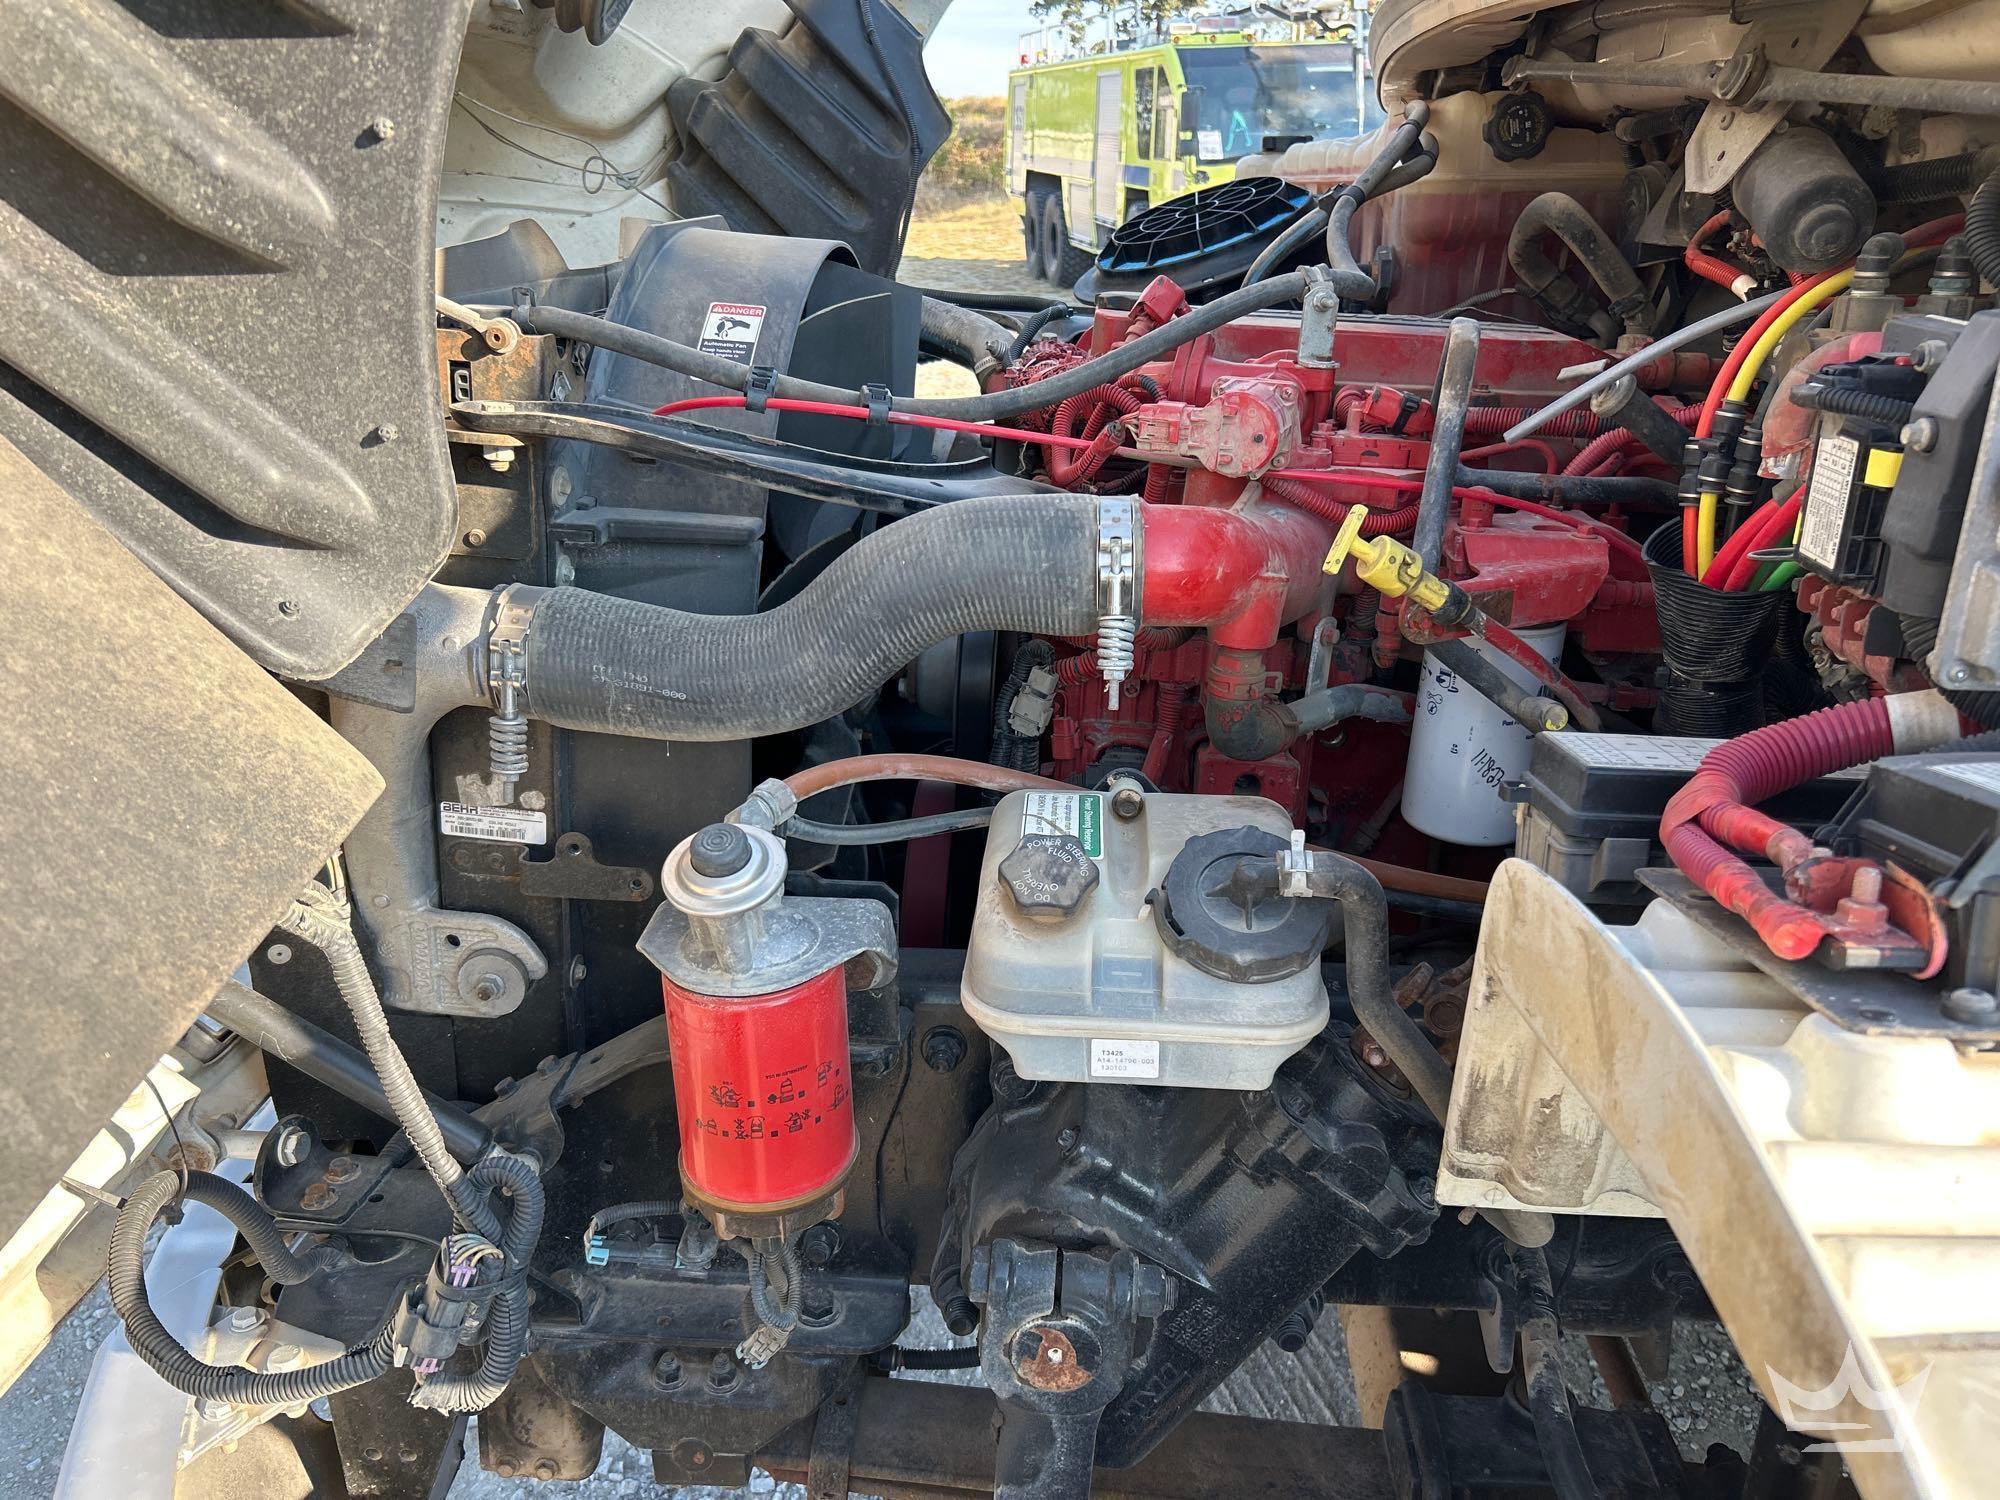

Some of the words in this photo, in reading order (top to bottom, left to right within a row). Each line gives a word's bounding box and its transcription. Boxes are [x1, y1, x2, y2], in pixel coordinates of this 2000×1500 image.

[723, 306, 763, 316] DANGER
[1838, 479, 1850, 520] WITHOUT
[443, 802, 479, 815] BEHR
[1084, 797, 1094, 811] Power
[1082, 810, 1094, 829] Steering
[1083, 828, 1094, 851] Reservoir
[1026, 838, 1062, 850] POWER
[1065, 843, 1089, 877] STEERING
[1048, 847, 1072, 863] FLUID
[1013, 879, 1031, 895] NOT
[1022, 868, 1059, 891] OVERFILL
[1033, 893, 1051, 902] DO
